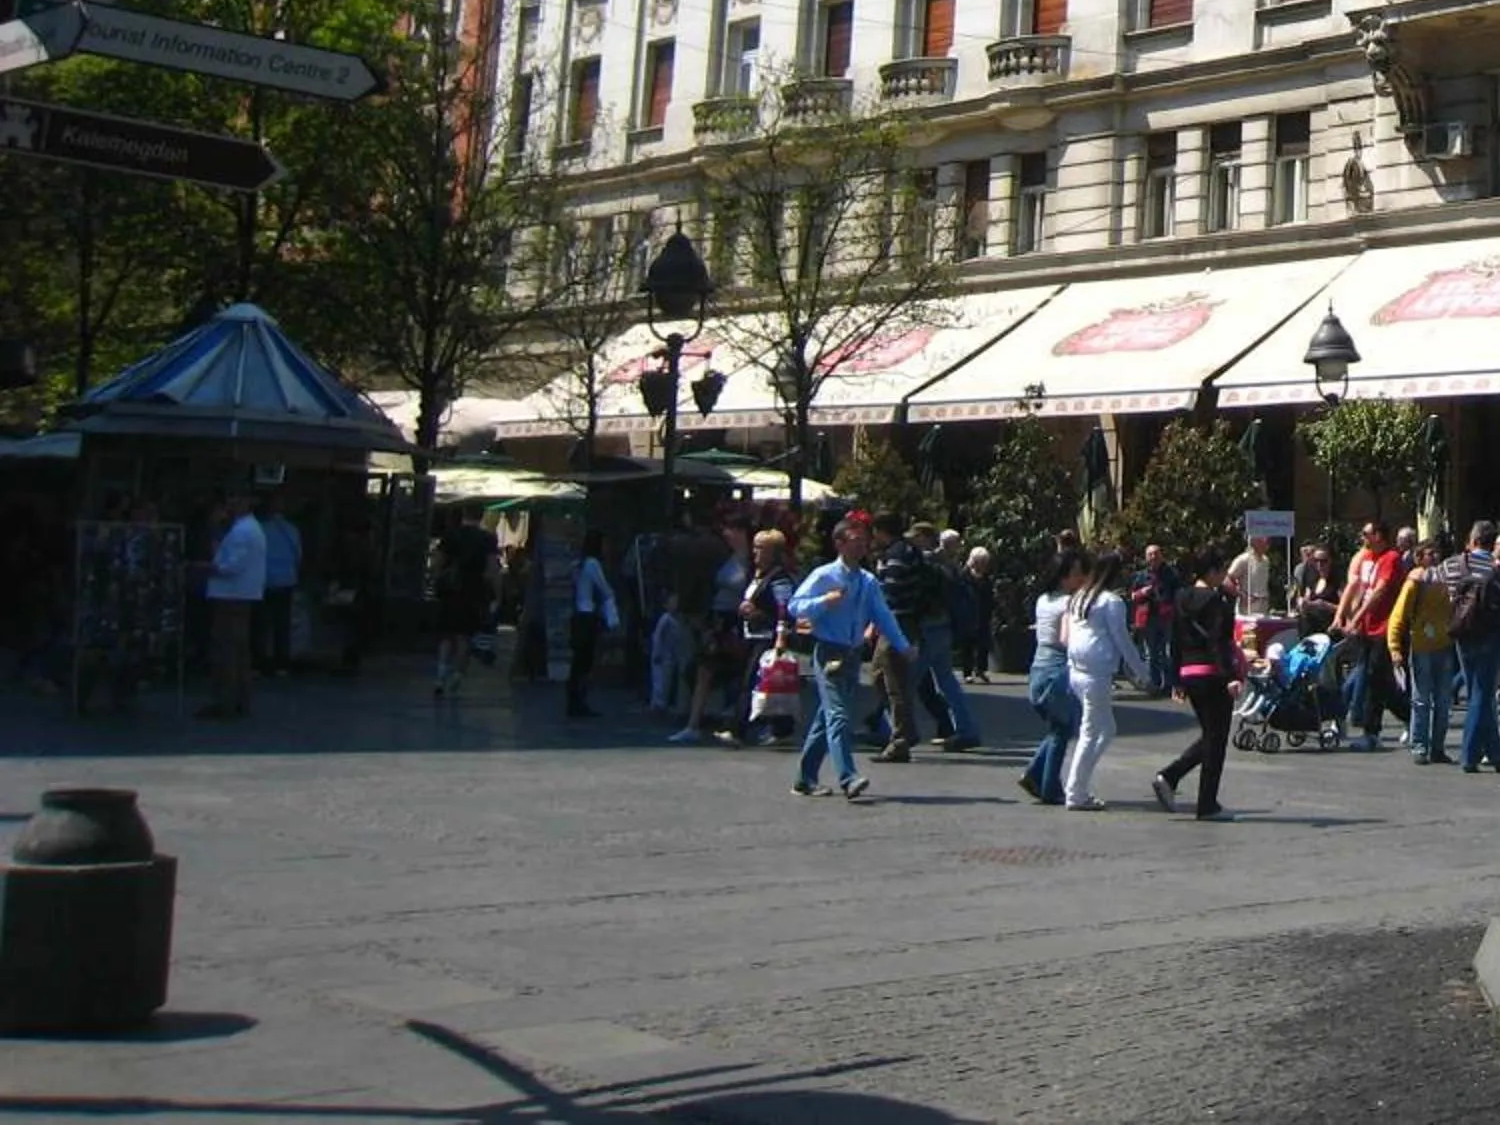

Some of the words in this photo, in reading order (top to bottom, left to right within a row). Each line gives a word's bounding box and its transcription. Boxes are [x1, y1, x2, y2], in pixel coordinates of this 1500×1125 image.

[86, 22, 146, 46] ourist
[150, 34, 262, 70] Information
[268, 53, 332, 82] Centre
